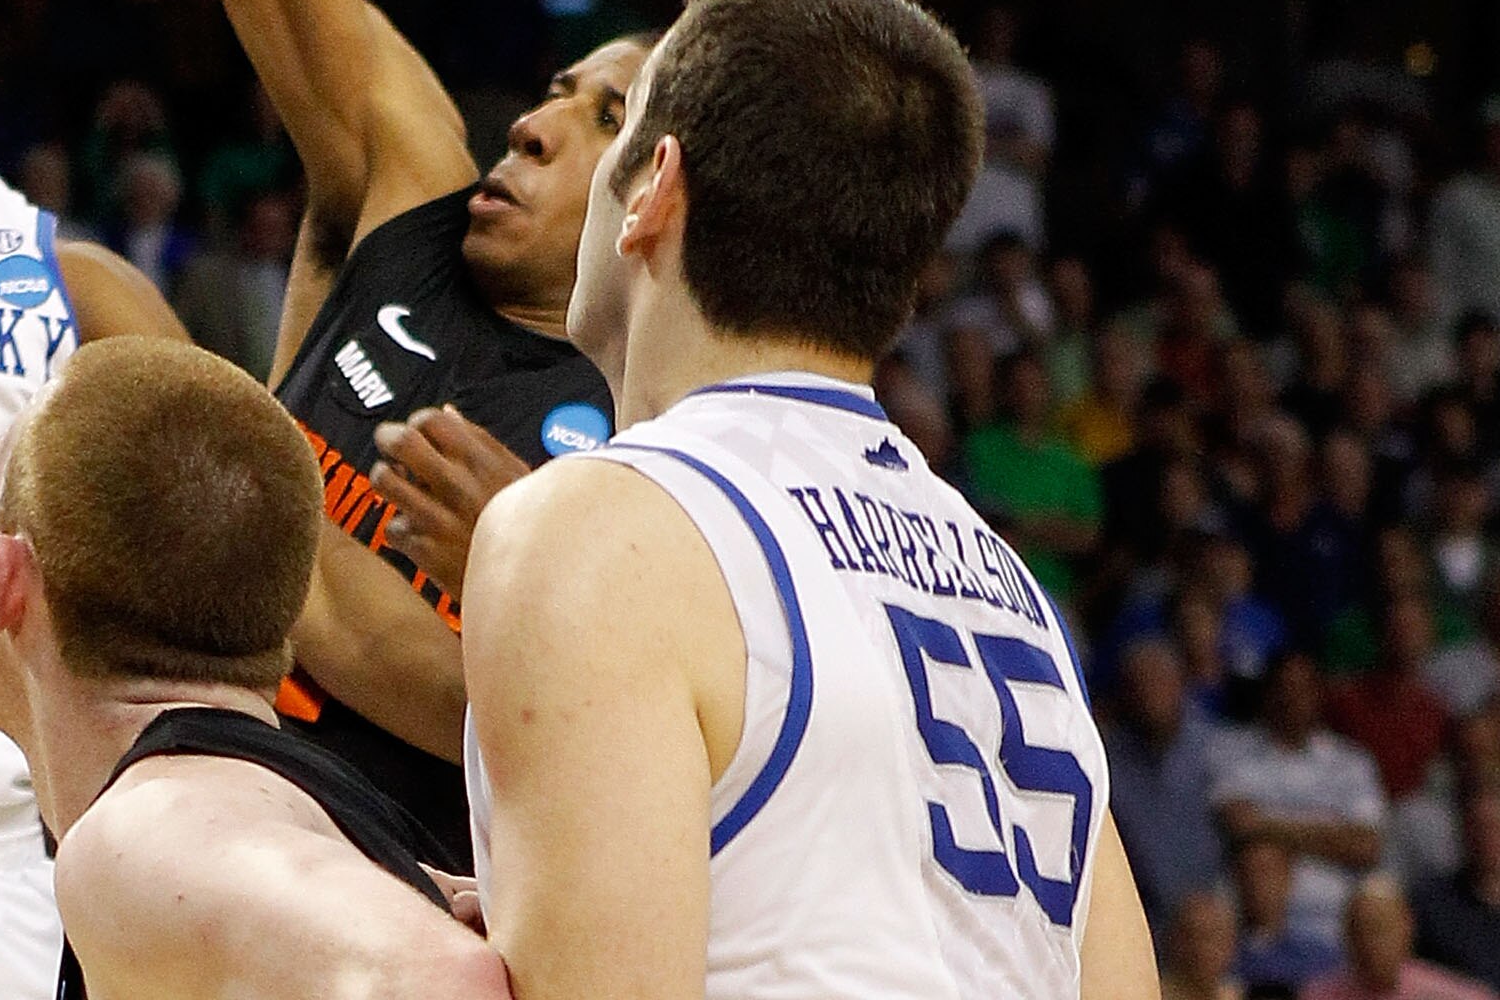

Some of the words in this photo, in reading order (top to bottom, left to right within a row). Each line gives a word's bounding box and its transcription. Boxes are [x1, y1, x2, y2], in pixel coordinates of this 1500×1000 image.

[334, 340, 394, 409] MARV
[786, 486, 1049, 630] HARRELLSON
[884, 603, 1093, 929] 55
